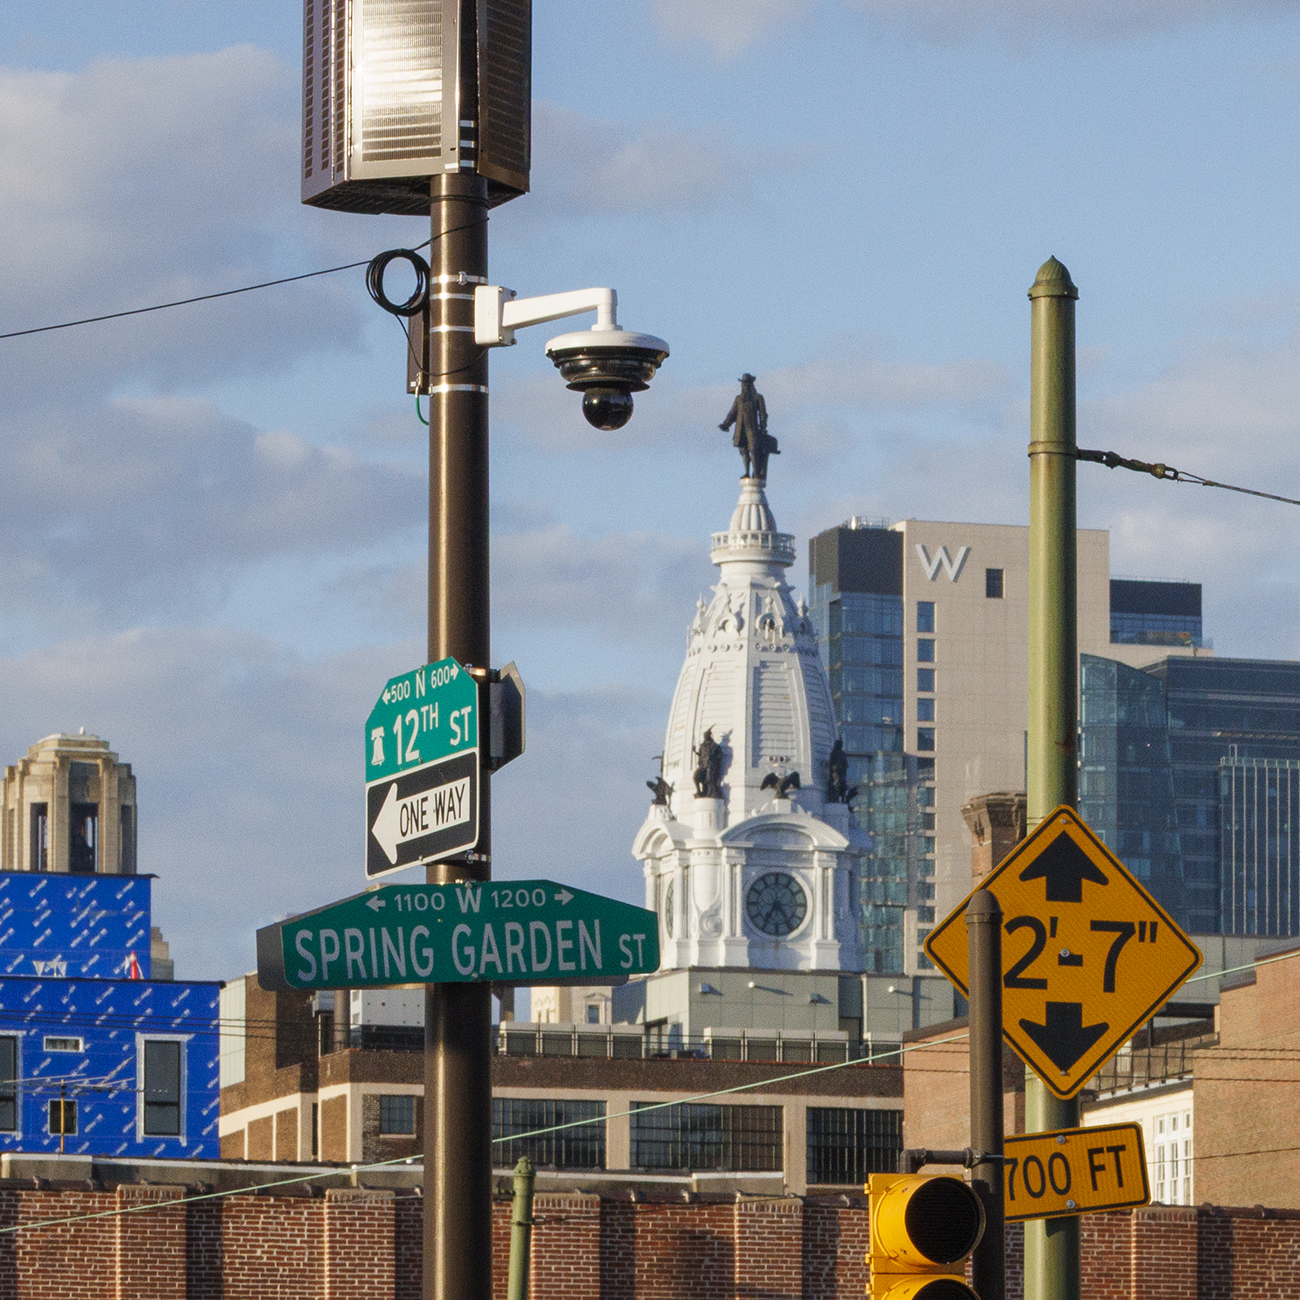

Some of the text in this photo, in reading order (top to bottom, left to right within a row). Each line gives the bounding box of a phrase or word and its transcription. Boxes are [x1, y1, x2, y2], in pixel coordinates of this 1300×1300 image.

[915, 543, 971, 583] W
[390, 665, 450, 704] 500 N 600
[393, 702, 472, 765] 12TH ST
[400, 783, 466, 836] ONE WAY
[394, 887, 547, 914] 1100 W 1200
[295, 919, 646, 982] SPRING GARDEN ST
[1087, 1145, 1127, 1192] FT
